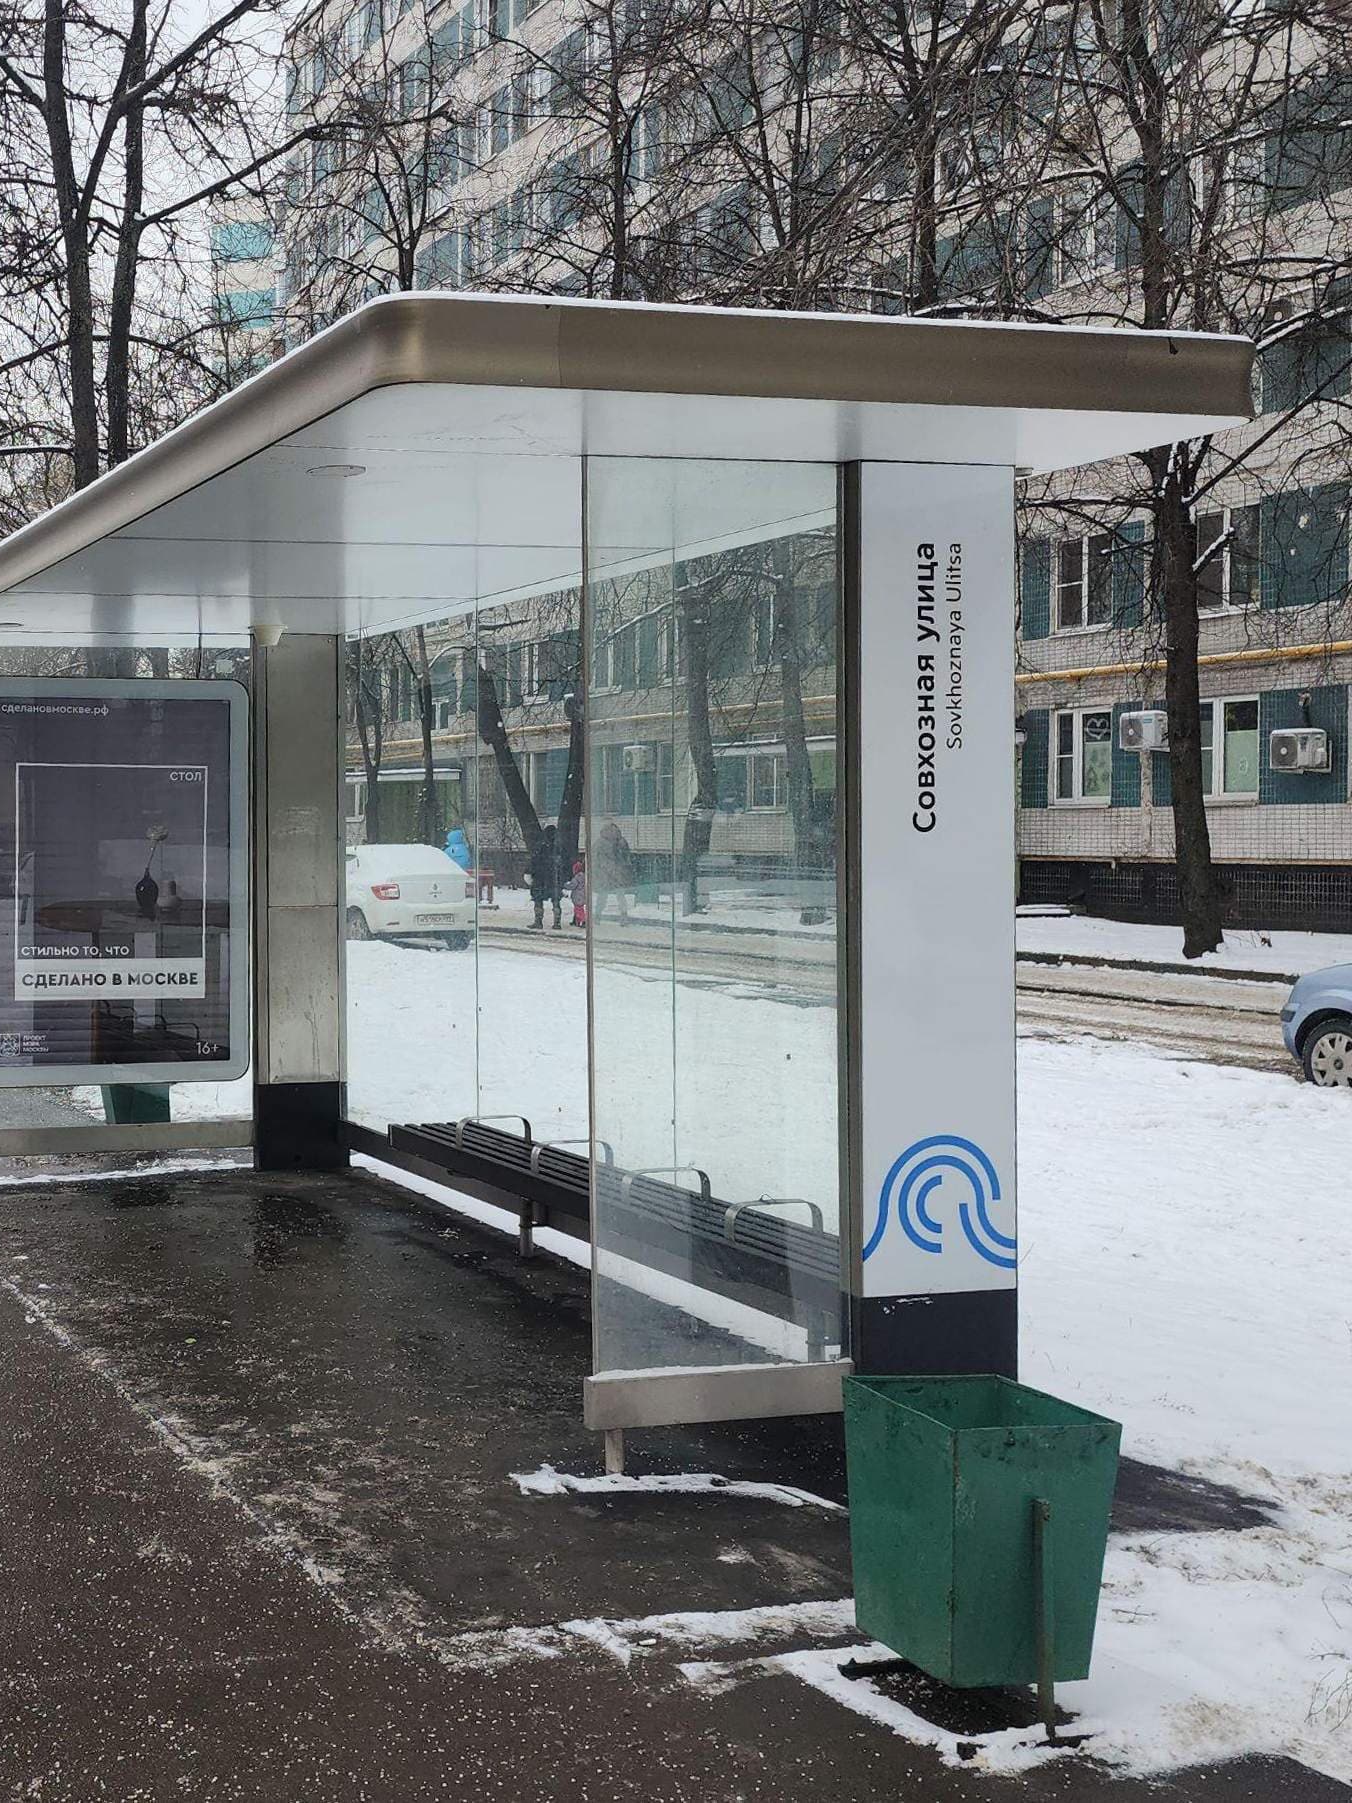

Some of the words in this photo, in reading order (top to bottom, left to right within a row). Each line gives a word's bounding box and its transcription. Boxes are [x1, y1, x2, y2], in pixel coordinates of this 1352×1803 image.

[945, 542, 962, 602] Ulitsa
[916, 542, 940, 642] улица
[945, 609, 965, 750] Sovkhoznaya
[1, 704, 109, 716] сделановмоскве.рф
[912, 653, 936, 832] Совхозная
[170, 771, 202, 781] СТОЛ
[21, 946, 79, 956] СТИЛЬНО
[83, 946, 102, 958] ТО,
[105, 946, 130, 956] ЧТО
[22, 973, 107, 988] СДЕЛАНО
[112, 974, 123, 986] В
[128, 973, 199, 986] МОСКВЕ
[196, 1041, 220, 1055] 16+
